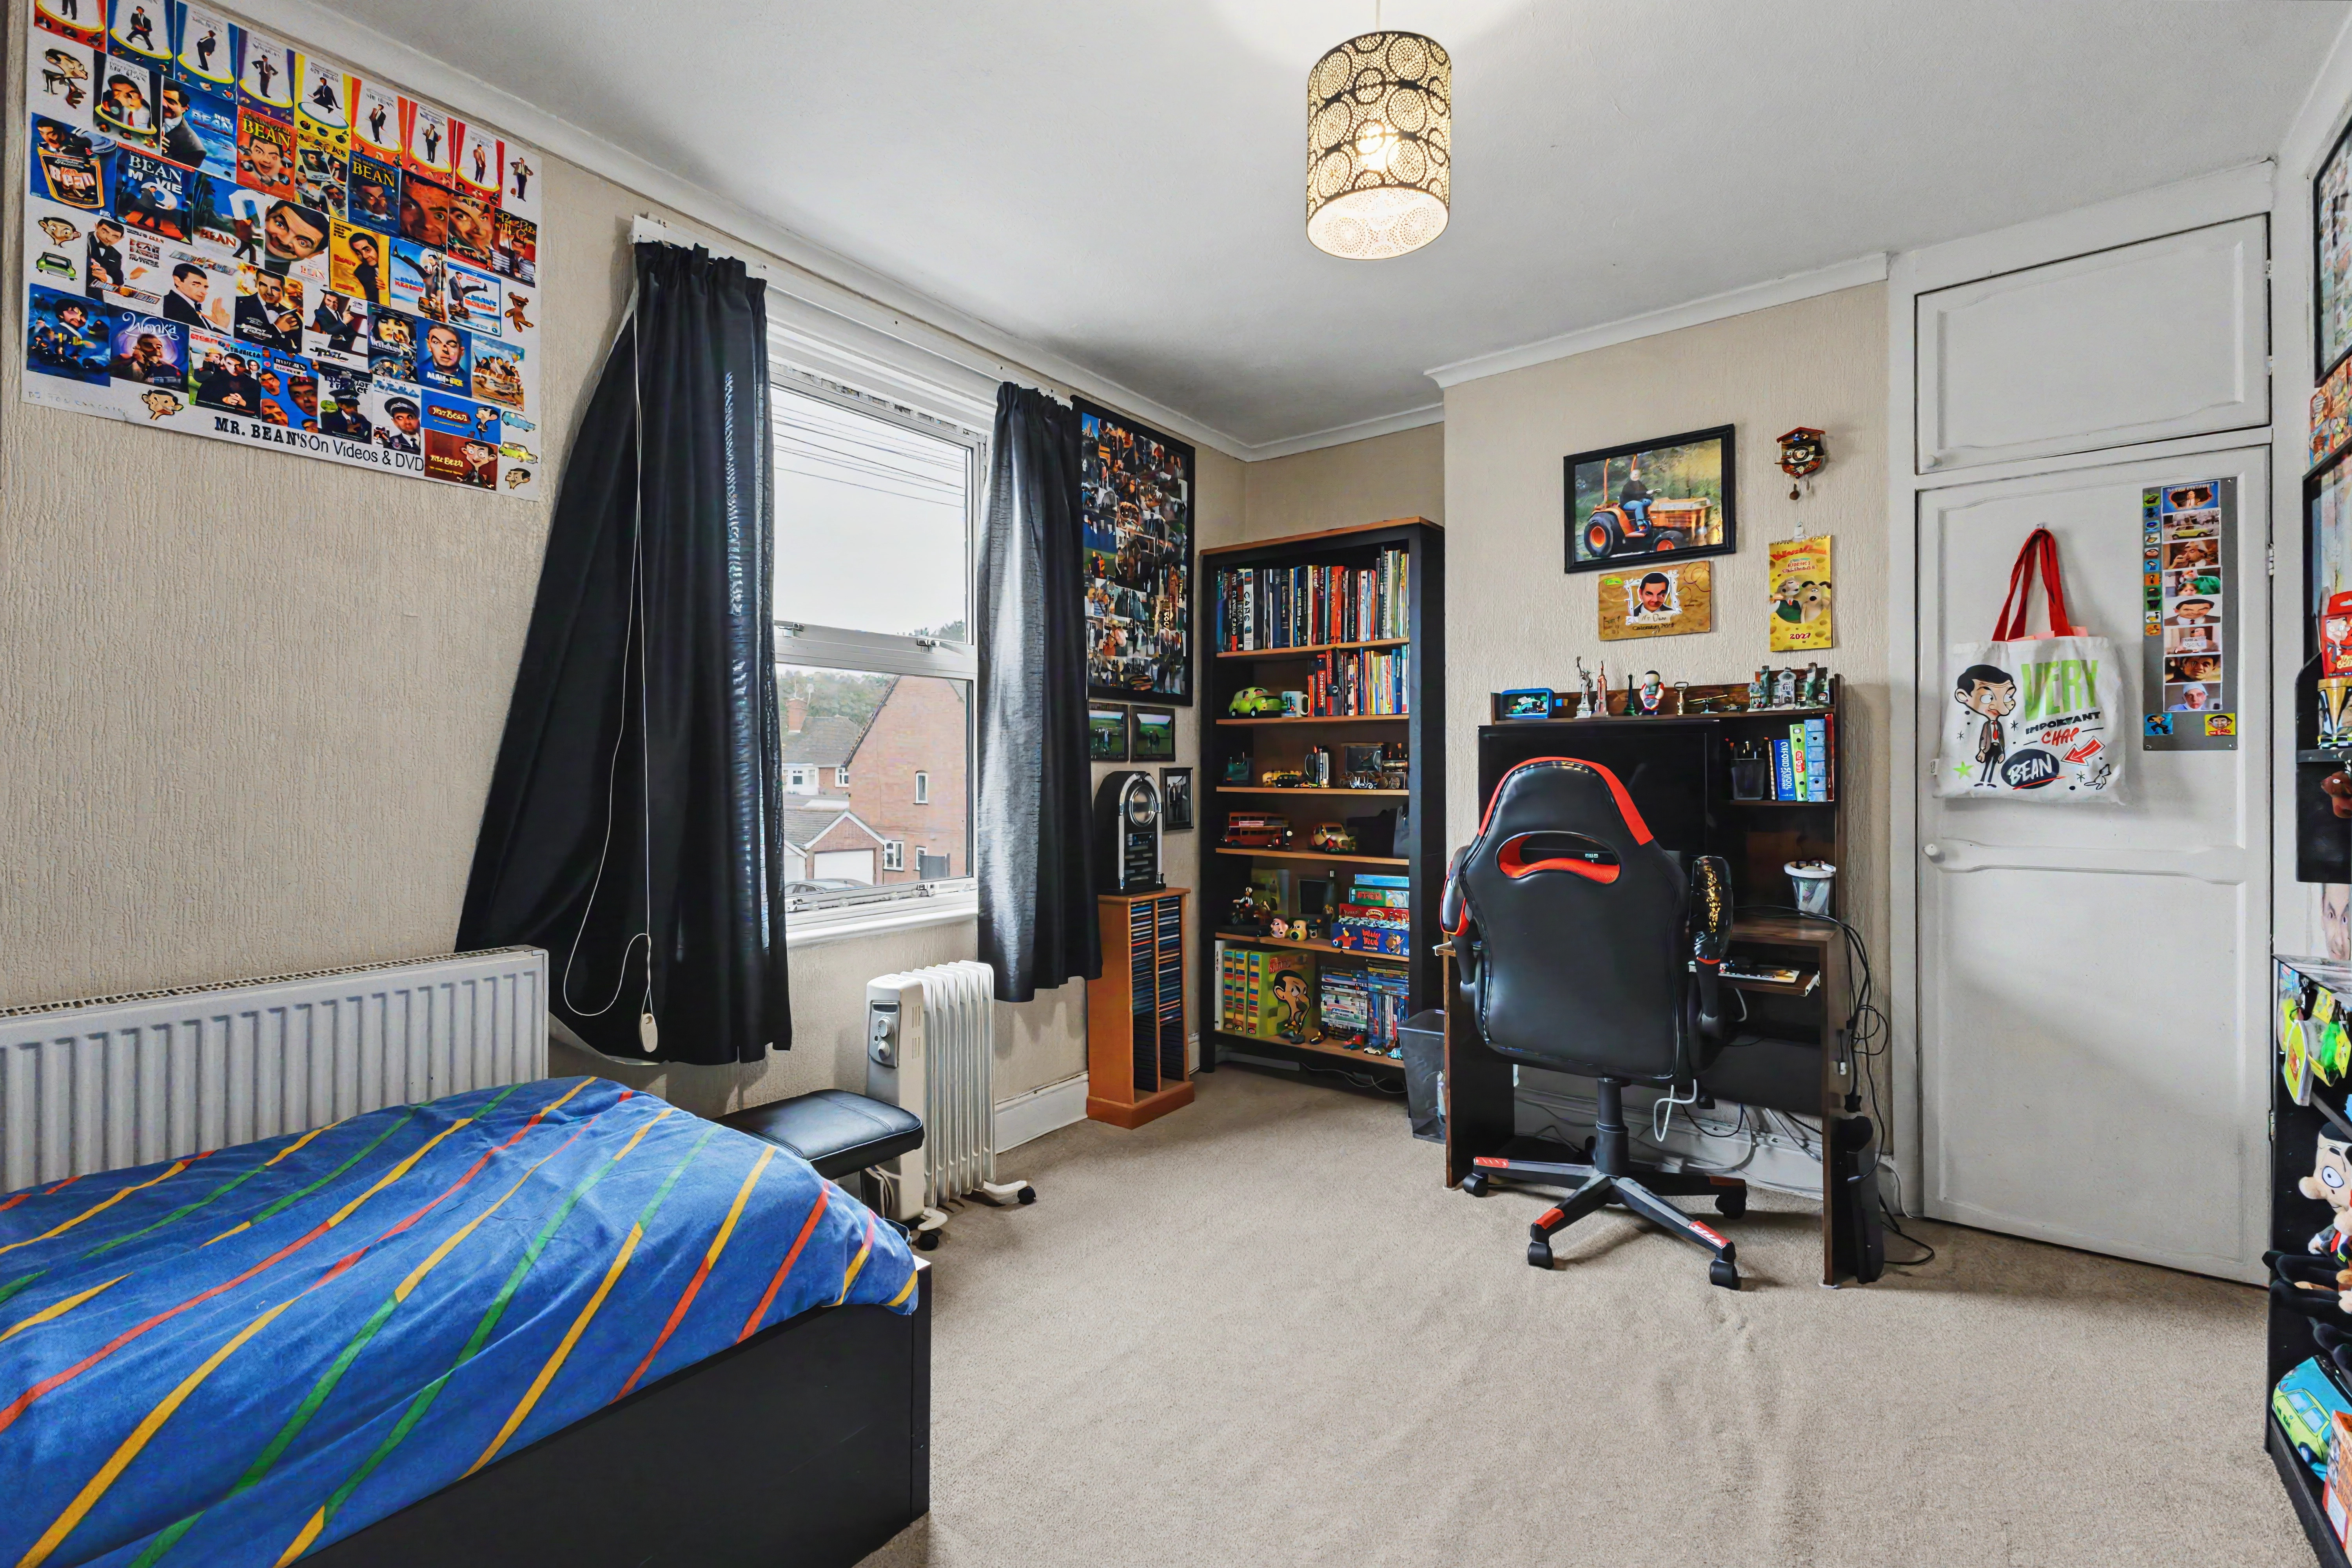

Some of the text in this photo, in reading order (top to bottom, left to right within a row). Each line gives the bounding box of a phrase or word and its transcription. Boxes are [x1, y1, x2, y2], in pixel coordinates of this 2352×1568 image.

[242, 118, 291, 149] BEAN
[129, 151, 183, 183] BEAN
[352, 161, 395, 187] BEAN
[122, 312, 180, 341] Wonka
[214, 416, 424, 472] MR. BEAN'S On Videos & DVD
[2020, 659, 2099, 722] VERY
[2025, 711, 2101, 735] IMPORTANT
[2041, 728, 2080, 746] CHAP
[2008, 753, 2054, 785] BEAN
